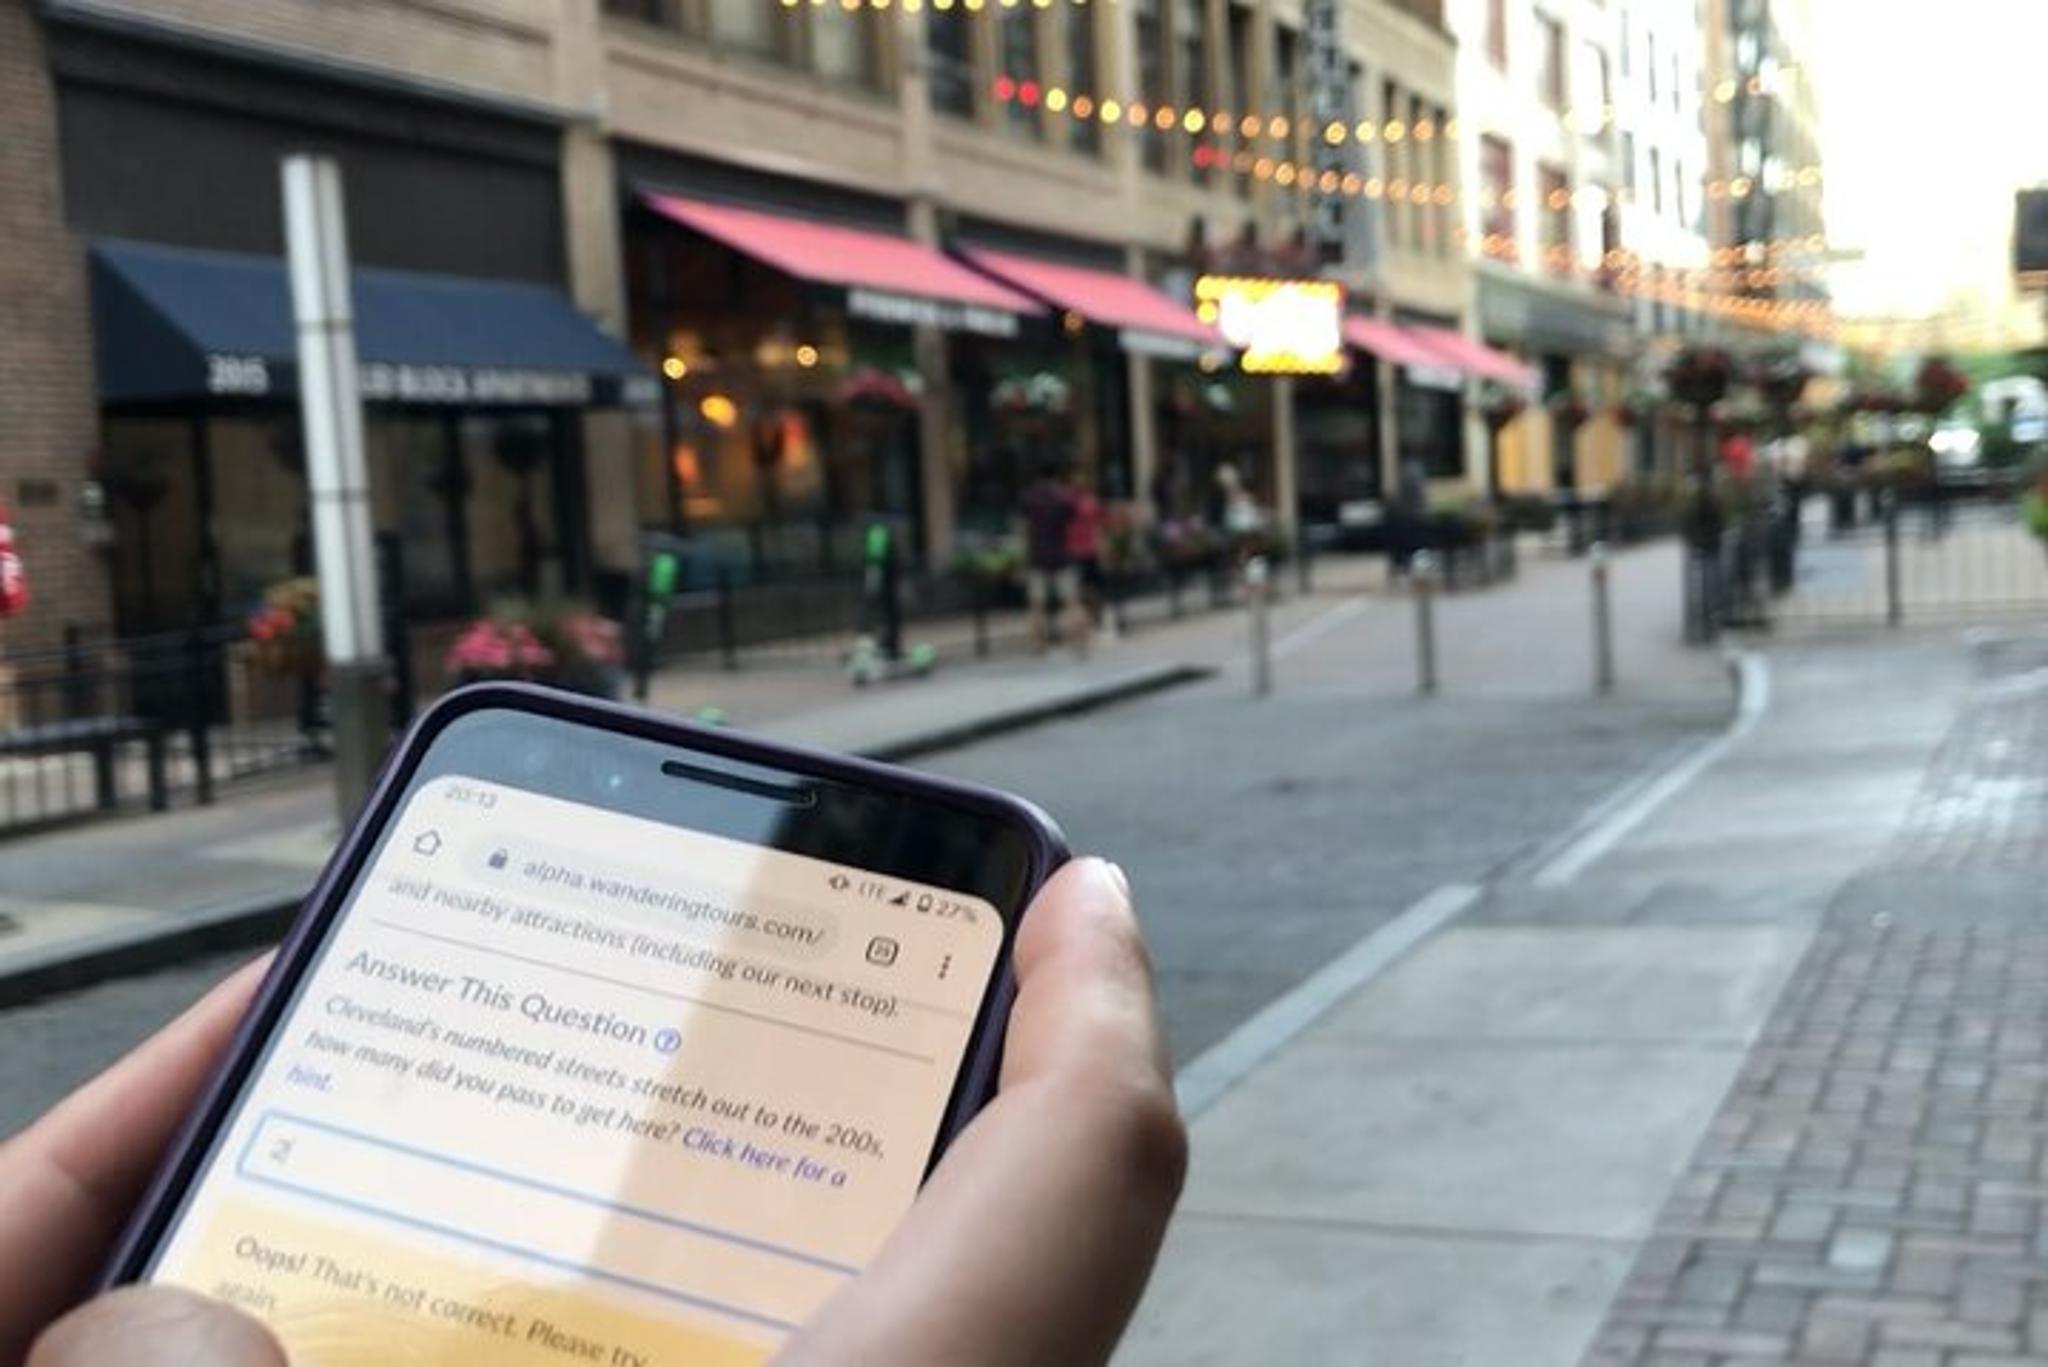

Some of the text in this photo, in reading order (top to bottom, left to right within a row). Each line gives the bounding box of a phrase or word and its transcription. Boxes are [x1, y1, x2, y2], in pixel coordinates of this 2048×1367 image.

[388, 877, 900, 1019] and nearby attractions (including our next stop).
[523, 857, 826, 946] alpha.wanderingtours.com/
[347, 949, 647, 1047] Answer This Question
[305, 1028, 848, 1188] how many did you pass to get here? Click here for a
[325, 996, 886, 1159] Cleveland's numbered streets stretch out to the 200s,
[235, 1234, 649, 1367] Oops! That's not correct. Please try
